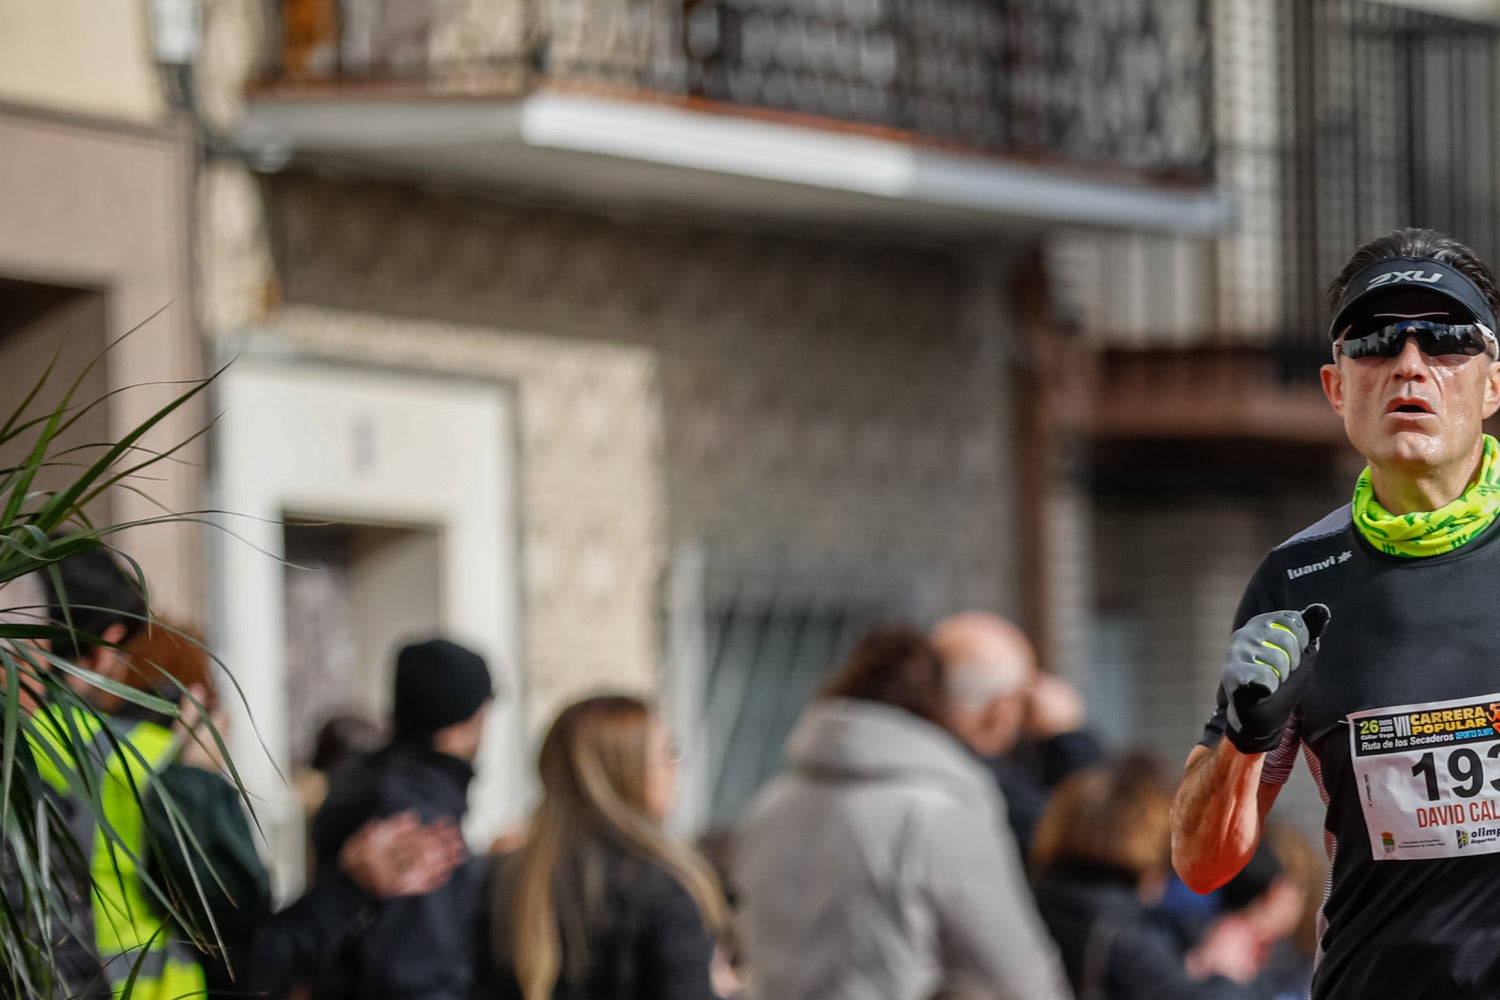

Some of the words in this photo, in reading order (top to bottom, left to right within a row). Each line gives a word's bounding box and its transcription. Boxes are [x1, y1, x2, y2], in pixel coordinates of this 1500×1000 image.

[1366, 270, 1443, 291] 2XU
[1286, 555, 1336, 580] luanvi
[1409, 706, 1486, 726] CARRERA
[1360, 719, 1379, 734] 26
[1411, 718, 1488, 735] POPULAR
[1361, 742, 1381, 750] Ruta
[1382, 740, 1393, 748] de
[1395, 738, 1408, 747] los
[1409, 732, 1454, 746] Secaderos
[1416, 803, 1465, 828] DAVID
